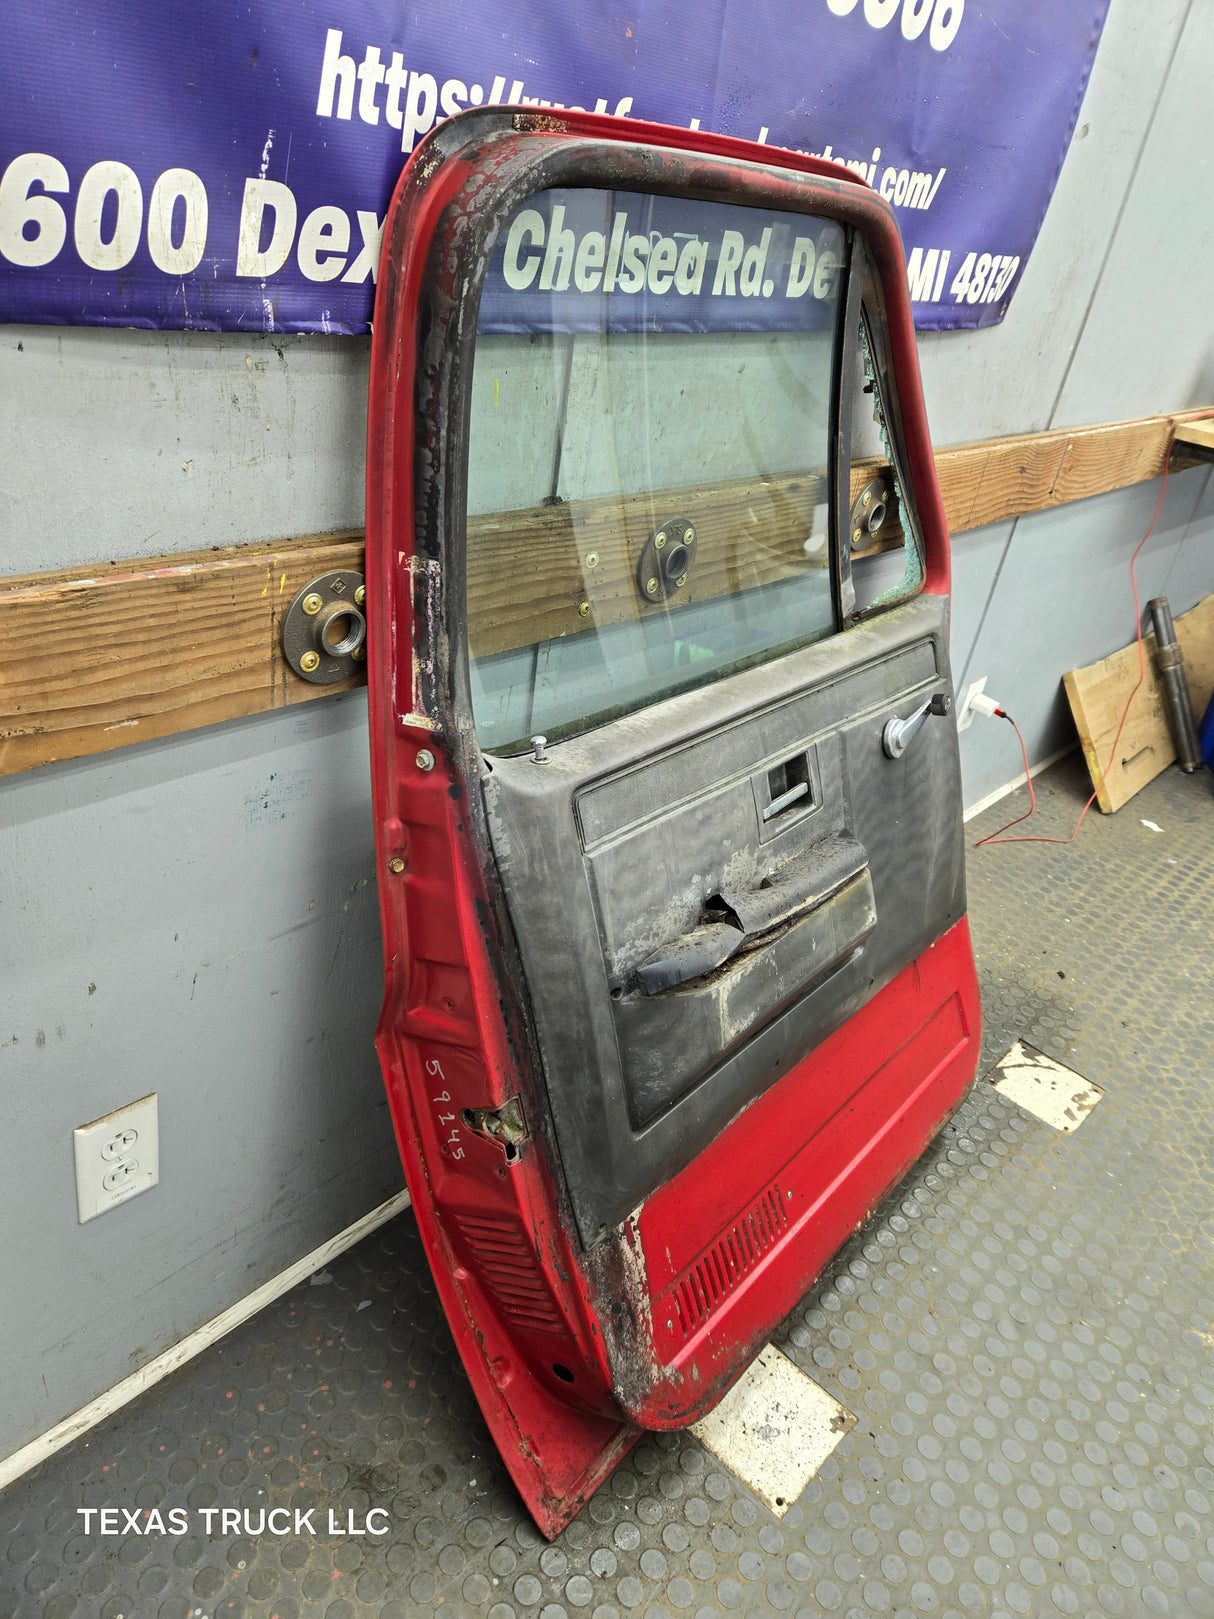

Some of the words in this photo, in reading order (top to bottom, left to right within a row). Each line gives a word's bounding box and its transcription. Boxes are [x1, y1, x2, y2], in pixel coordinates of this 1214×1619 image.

[0, 152, 208, 275] 600
[235, 177, 386, 284] Dex
[502, 205, 709, 295] Chelsea
[711, 228, 773, 298] Rd.
[785, 236, 837, 300] De
[907, 247, 951, 302] MI
[950, 252, 1020, 304] 48130
